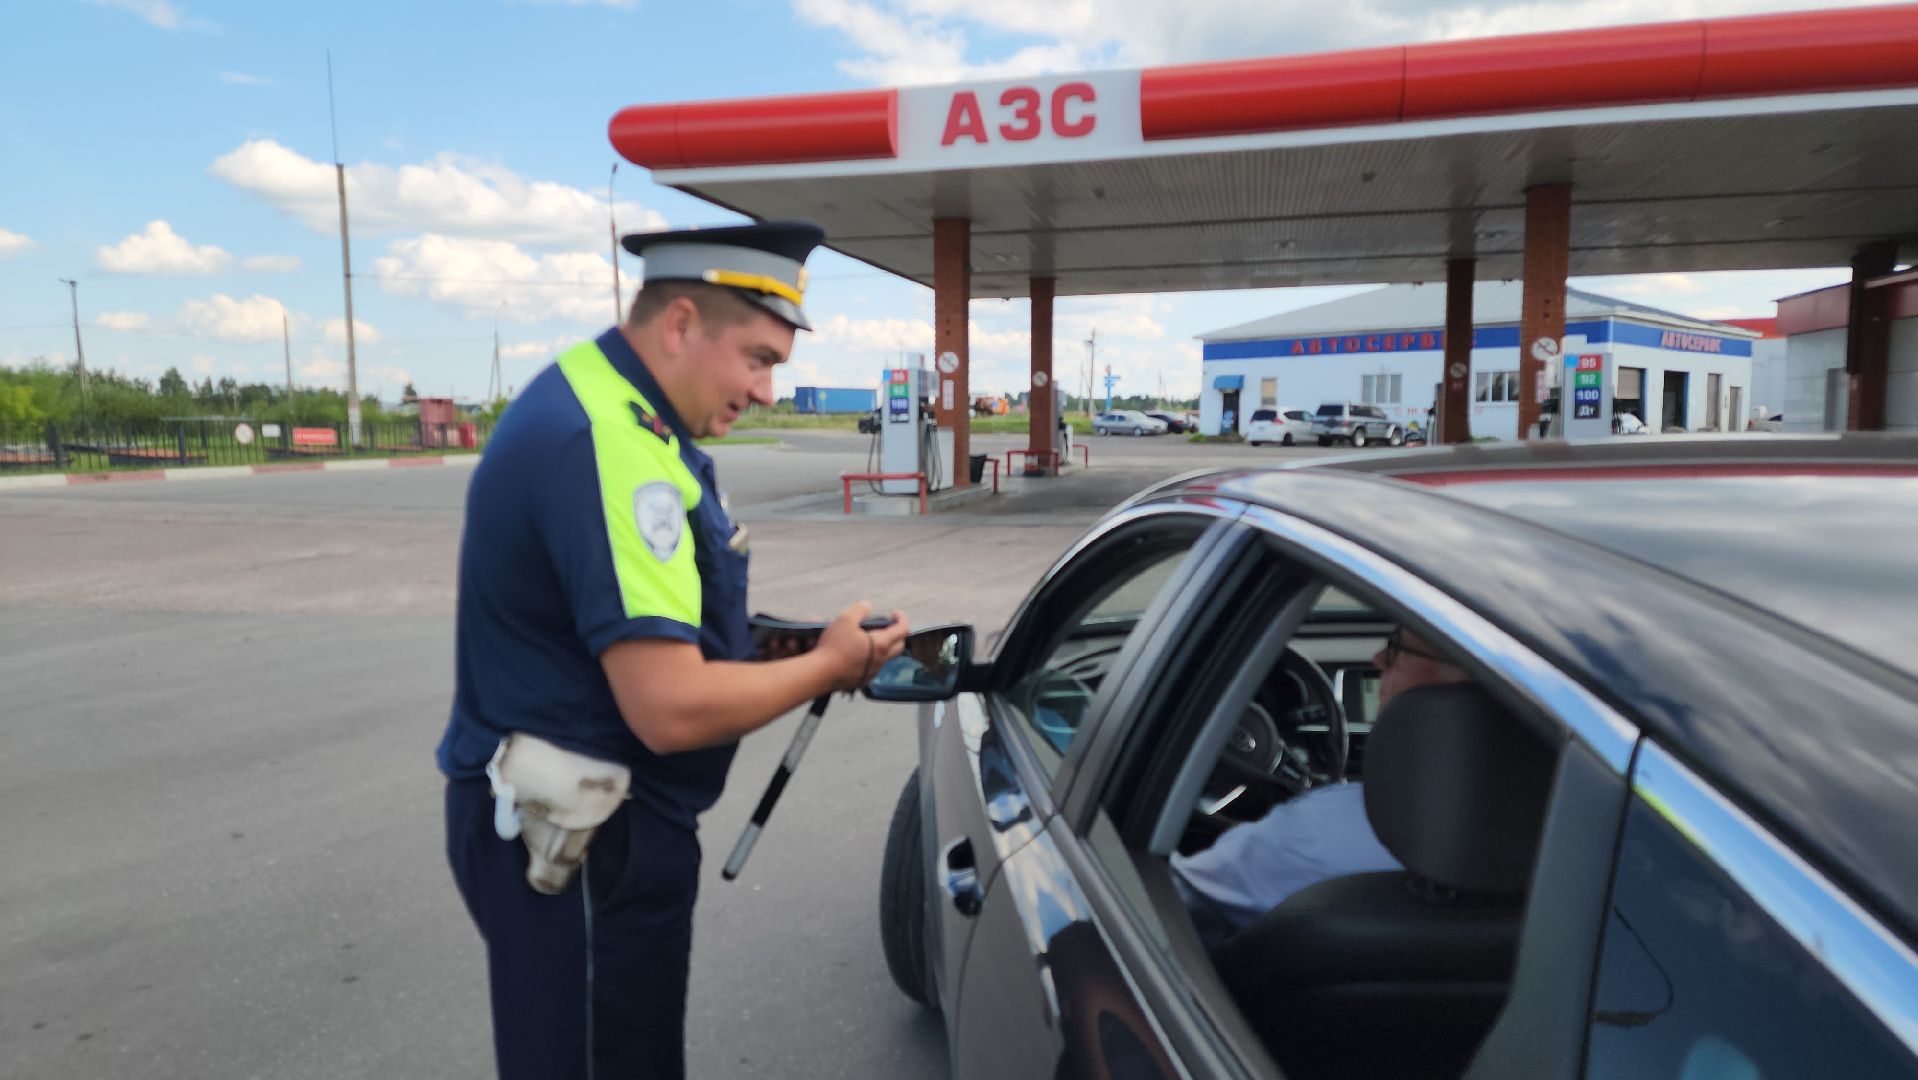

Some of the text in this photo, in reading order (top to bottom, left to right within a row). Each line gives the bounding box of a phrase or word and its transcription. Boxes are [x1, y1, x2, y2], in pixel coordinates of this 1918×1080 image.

[940, 82, 1097, 146] АЗС
[1291, 333, 1477, 355] АВТОСЕРВ
[1582, 357, 1597, 369] 95
[1581, 373, 1597, 385] 92
[1576, 389, 1600, 401] 100
